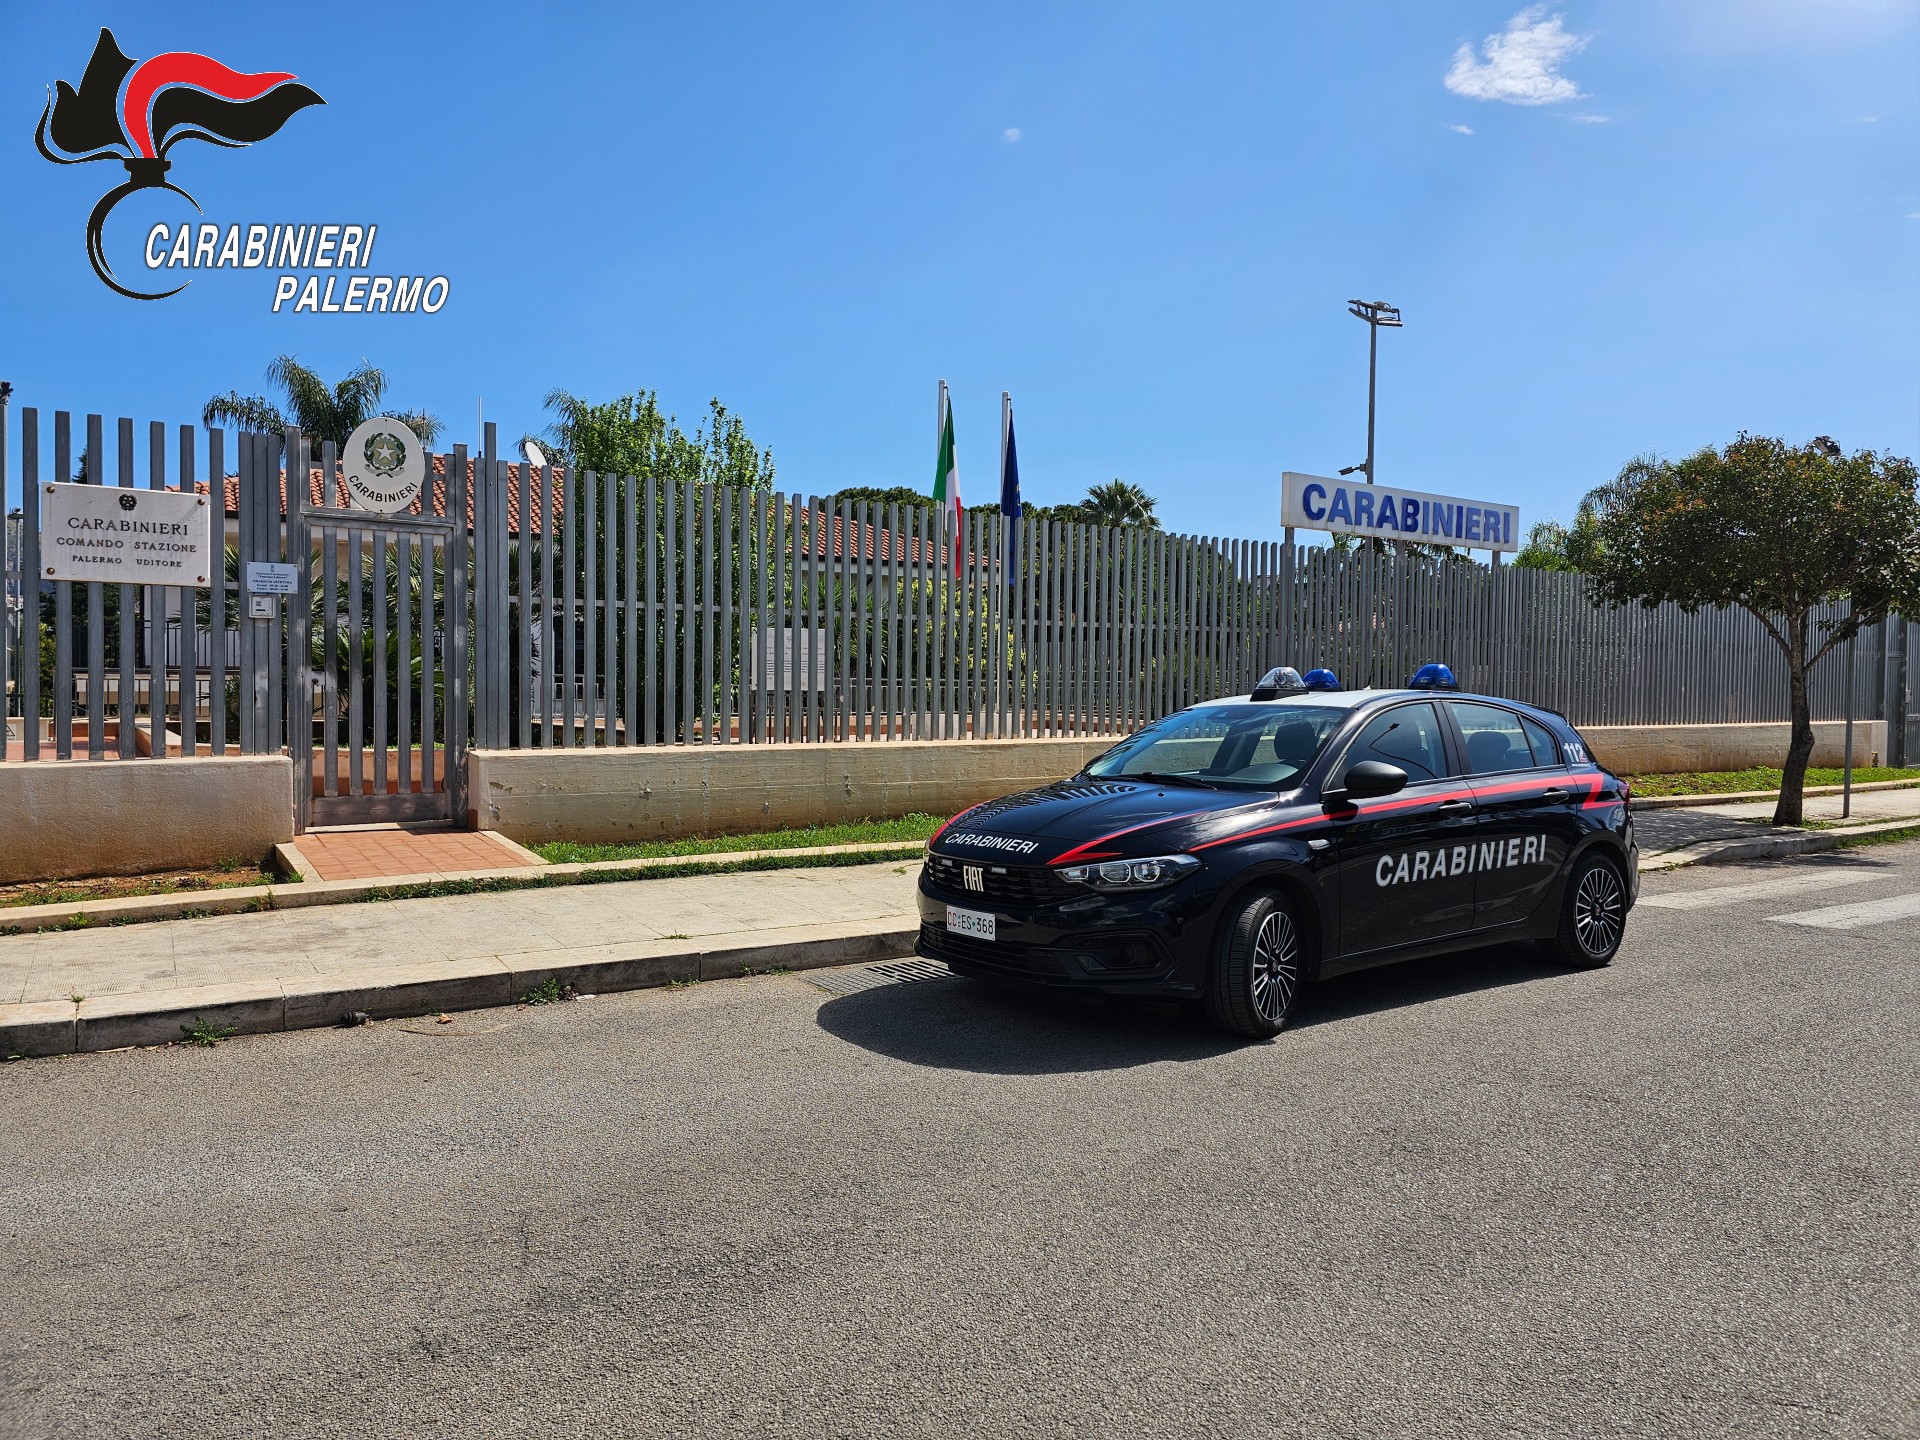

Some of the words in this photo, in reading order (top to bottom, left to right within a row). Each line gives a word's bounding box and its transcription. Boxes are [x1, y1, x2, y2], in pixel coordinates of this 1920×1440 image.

[349, 475, 418, 503] CARABINIERI
[1303, 483, 1511, 544] CARABINIERI
[67, 517, 188, 536] CARABINIERI
[56, 537, 124, 549] COMANDO
[134, 541, 197, 553] STAZIONE
[72, 555, 122, 564] PALERMO
[136, 558, 182, 568] UDITORE
[1563, 742, 1587, 762] 112
[945, 833, 1039, 854] CARABINIERI
[1375, 834, 1547, 887] CARABINIERI
[963, 865, 984, 892] FIAT
